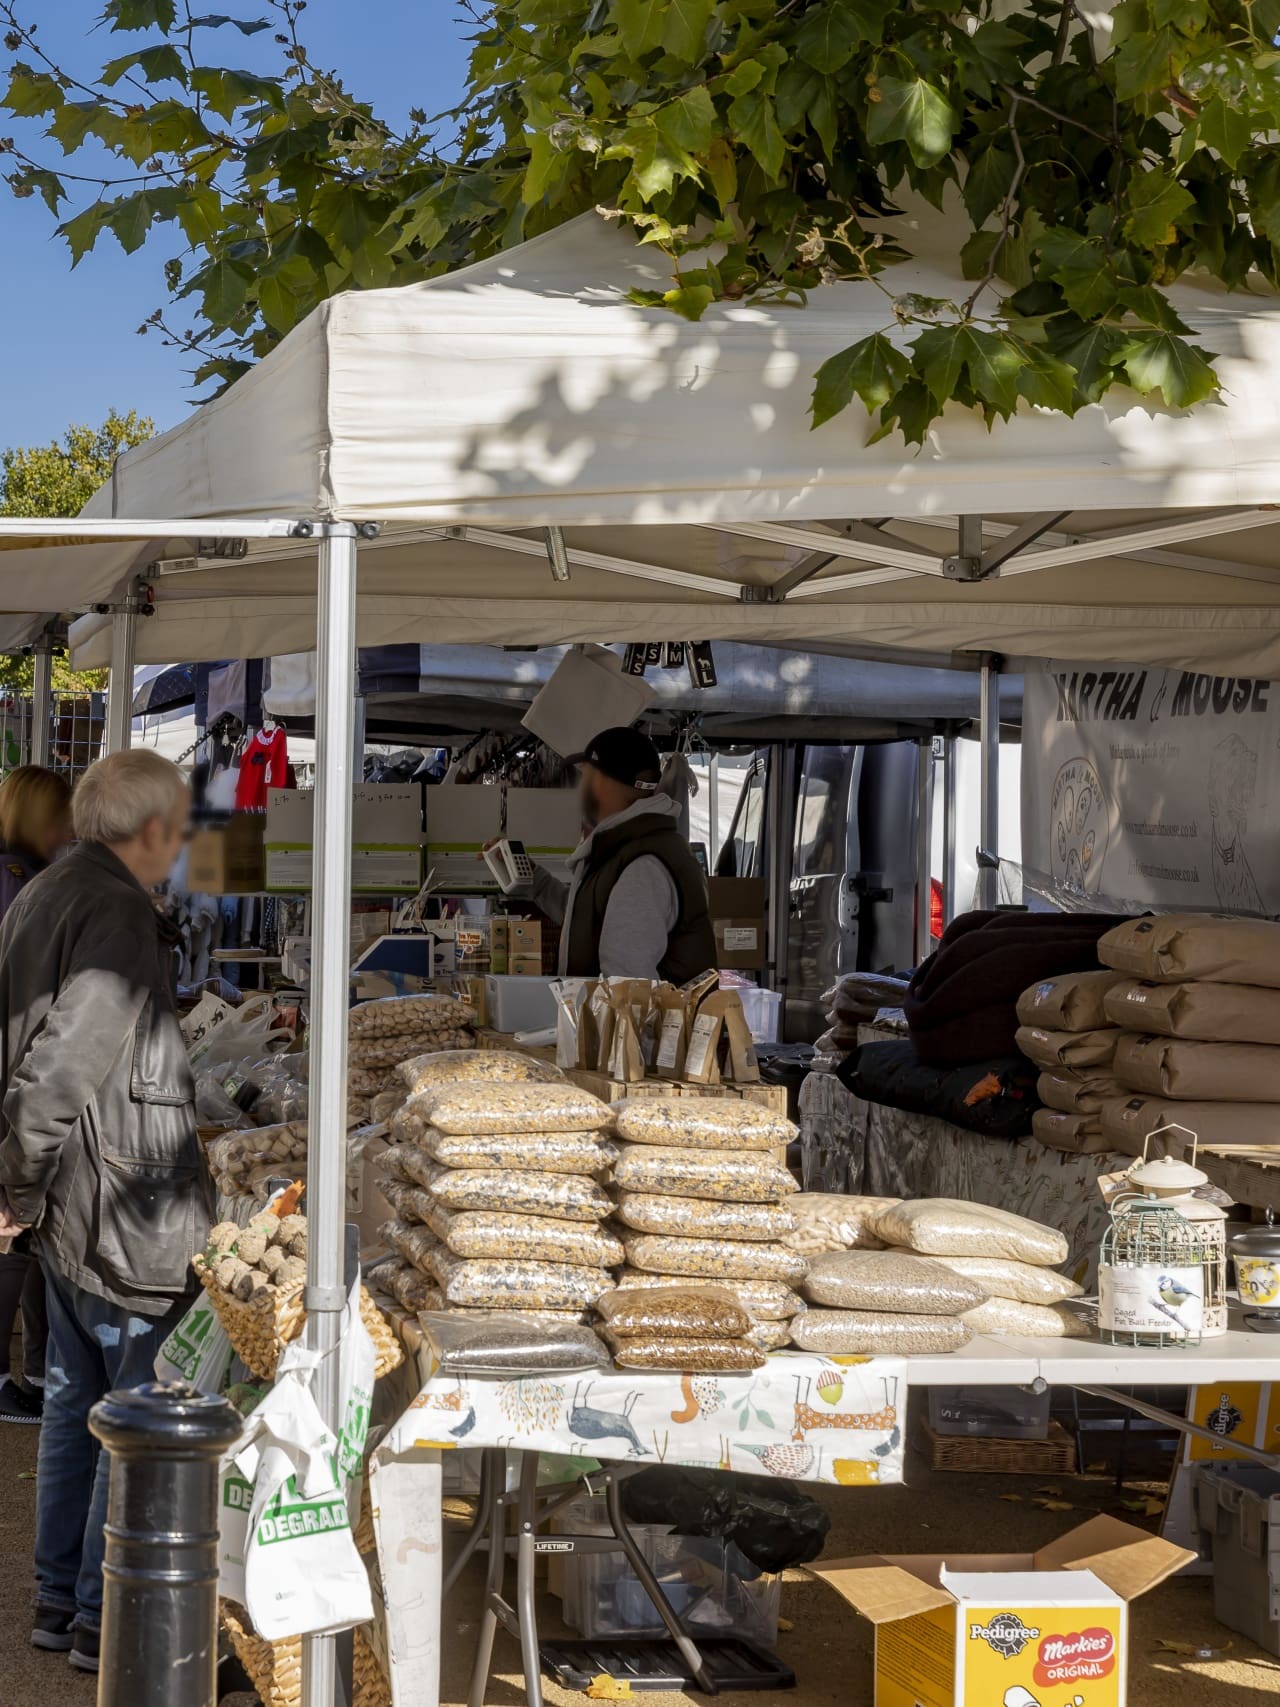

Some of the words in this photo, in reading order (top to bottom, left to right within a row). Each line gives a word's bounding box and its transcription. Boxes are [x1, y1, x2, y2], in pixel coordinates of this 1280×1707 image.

[648, 648, 657, 659] S
[670, 651, 681, 662] M
[702, 671, 712, 683] L
[1171, 671, 1270, 717] MOOSE
[970, 1624, 1040, 1643] Pedigree
[1043, 1635, 1107, 1662] Markies
[1047, 1662, 1104, 1680] ORIGINAL
